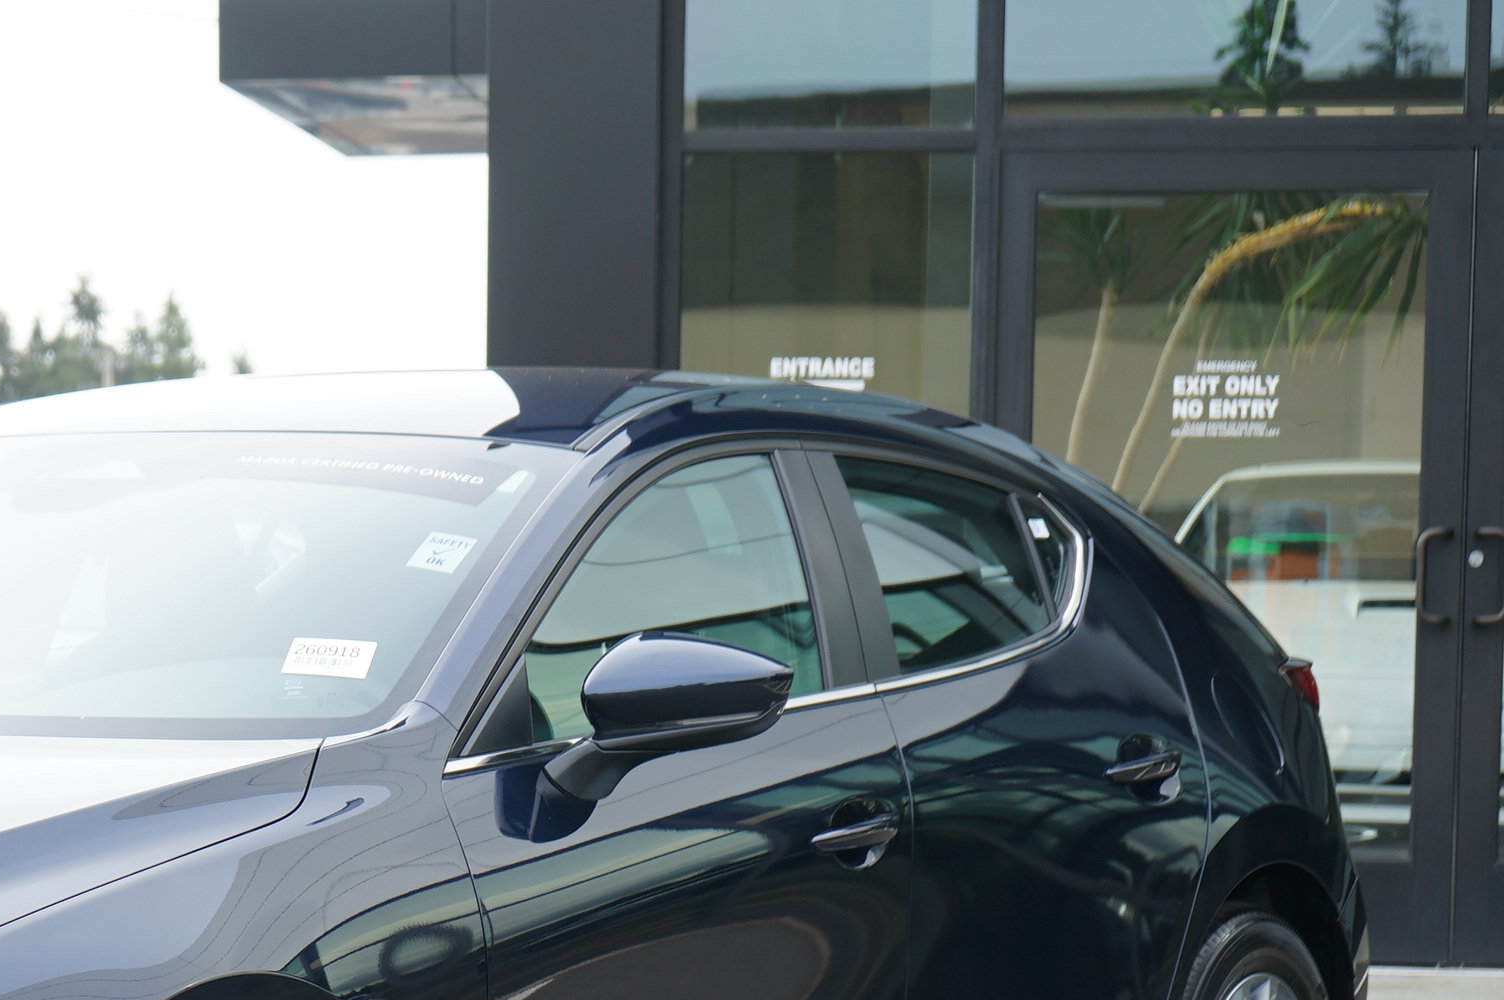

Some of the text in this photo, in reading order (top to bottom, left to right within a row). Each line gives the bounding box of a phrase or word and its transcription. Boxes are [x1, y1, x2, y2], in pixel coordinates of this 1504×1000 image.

[770, 356, 875, 378] ENTRANCE
[1173, 375, 1280, 396] EXIT ONLY
[1172, 398, 1280, 420] NO ENTRY
[301, 457, 380, 471] CERTIFIED
[383, 463, 485, 485] PRE-OWNED
[428, 536, 470, 549] SAFETY
[426, 556, 446, 567] OK
[294, 643, 360, 658] 260918
